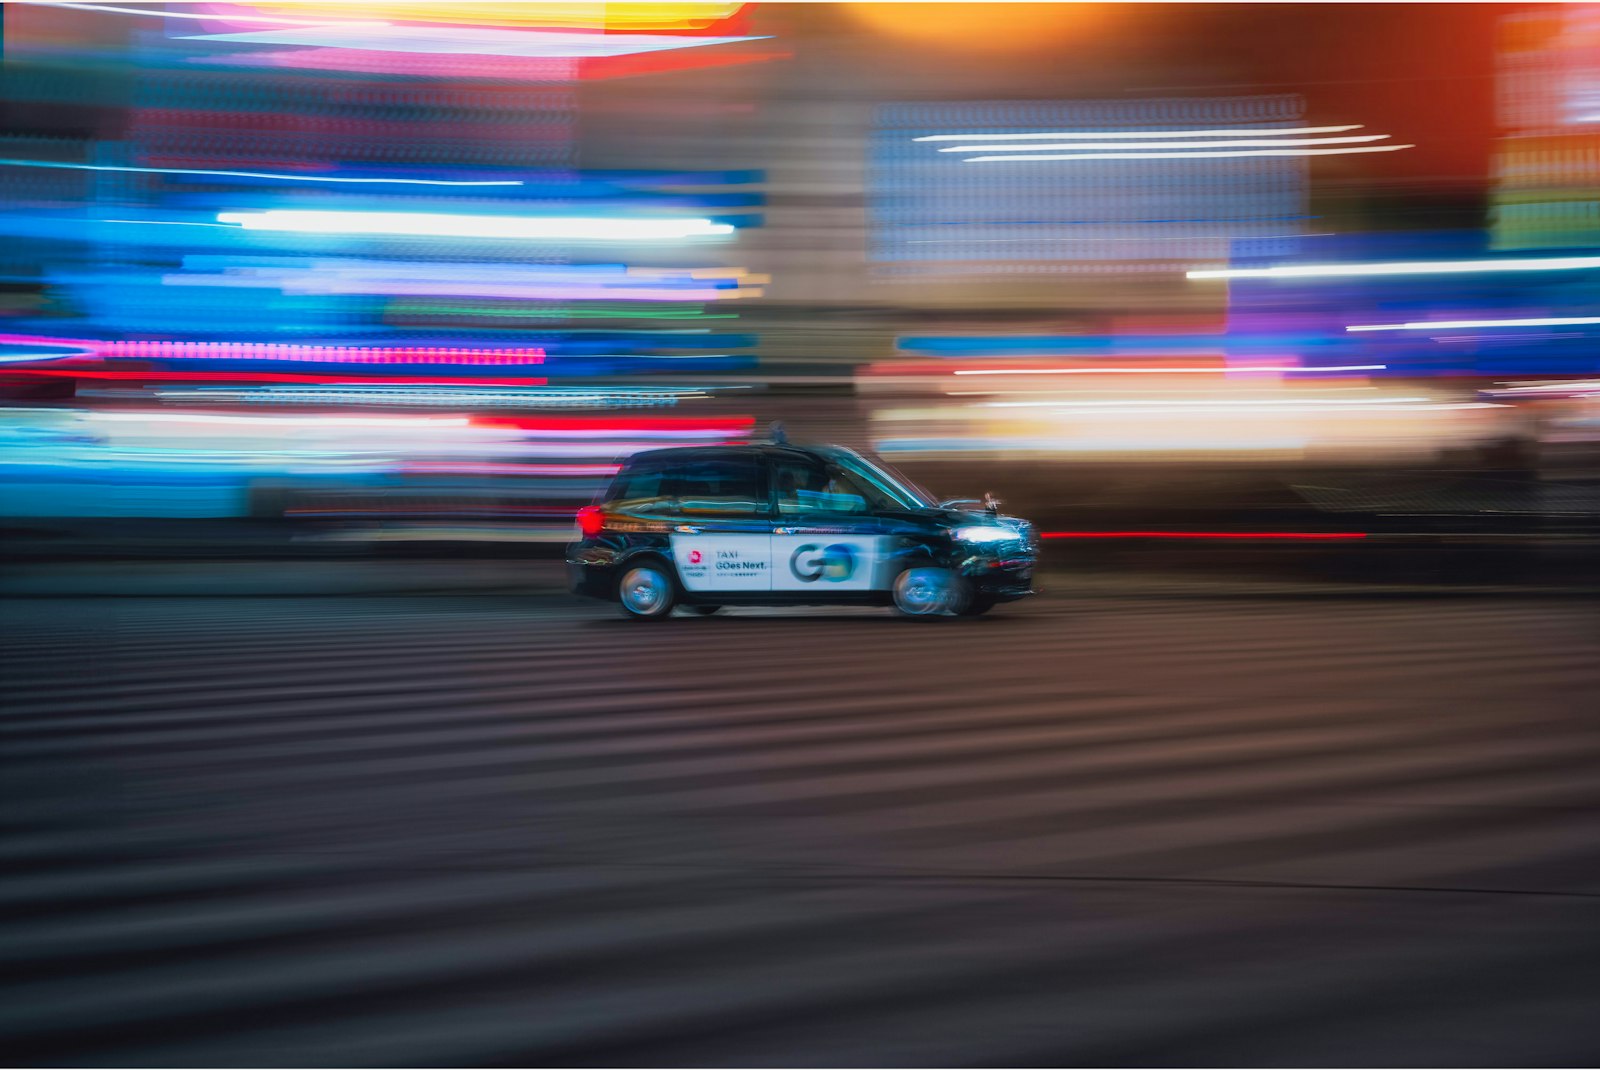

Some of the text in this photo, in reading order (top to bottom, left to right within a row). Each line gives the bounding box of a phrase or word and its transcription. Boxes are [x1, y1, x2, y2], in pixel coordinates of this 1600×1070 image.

[716, 551, 738, 559] TAXI
[715, 561, 741, 570] GOes
[742, 561, 767, 570] Next.
[789, 543, 859, 583] GO
